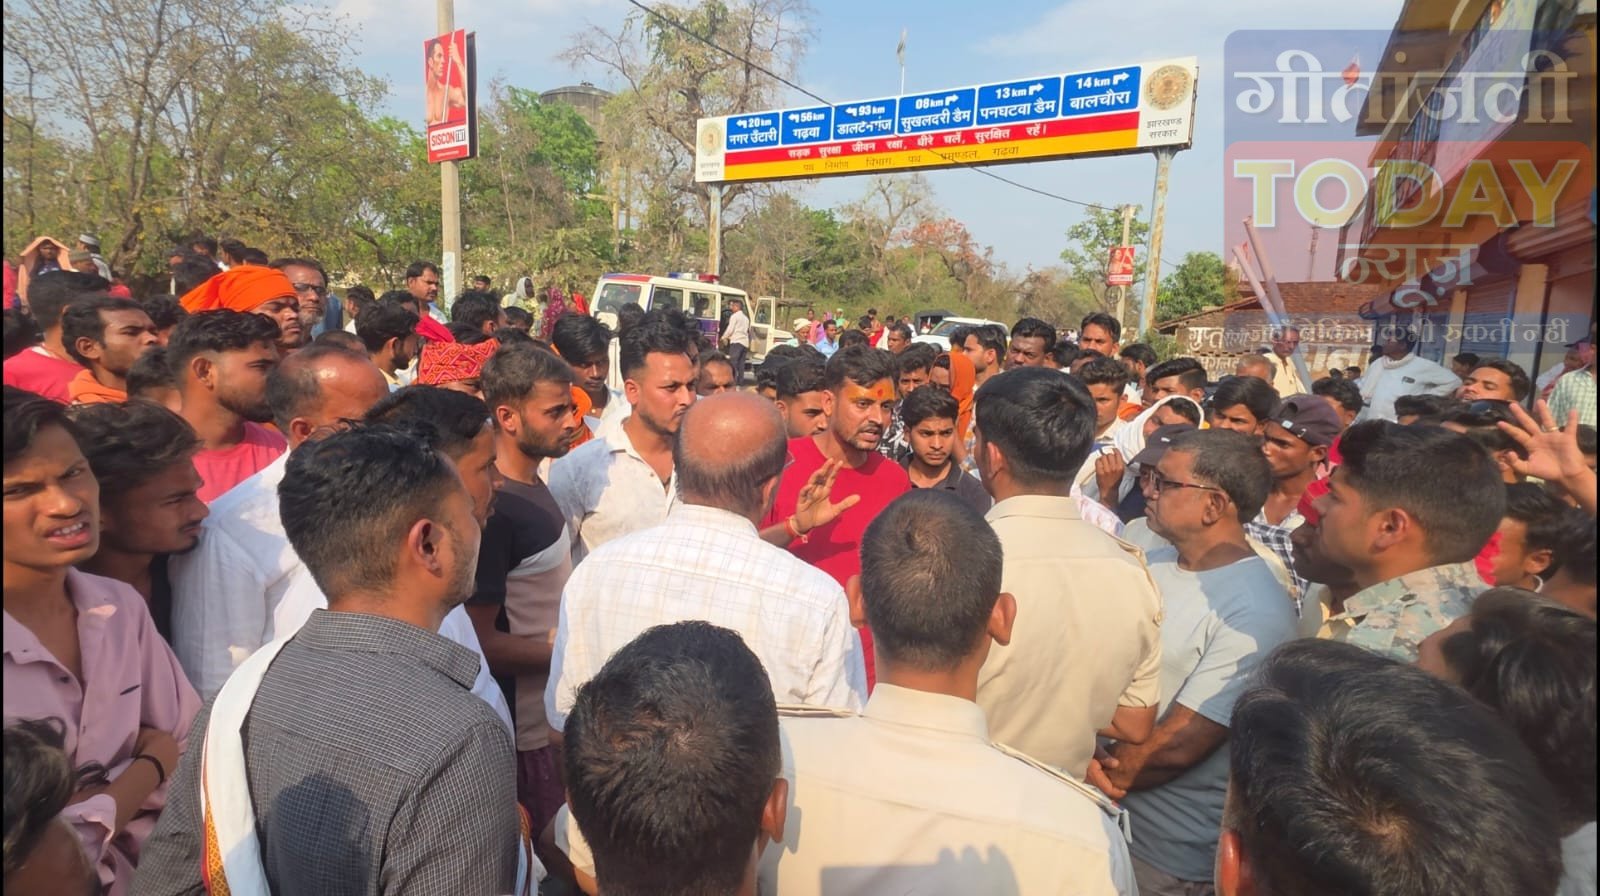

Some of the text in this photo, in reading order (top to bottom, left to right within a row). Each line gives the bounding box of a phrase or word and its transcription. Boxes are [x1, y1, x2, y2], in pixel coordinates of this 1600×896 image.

[1076, 76, 1110, 89] 14 km
[995, 86, 1027, 99] 13 km
[915, 98, 943, 110] 08 km
[1069, 89, 1131, 111] बालचौरा
[858, 105, 885, 116] 93 km
[979, 98, 1056, 119] पनघटवा डैम
[748, 118, 772, 128] 20 km
[800, 111, 825, 122] 56 km
[901, 107, 971, 132] सुखलदरी डैम
[431, 130, 455, 147] SISCON
[729, 134, 749, 145] नगर
[793, 126, 820, 140] गढ़वा
[1149, 129, 1178, 140] सरकार
[788, 148, 811, 159] सड़क
[818, 145, 842, 159] सुरक्षा
[851, 141, 875, 153] जीवन
[917, 134, 934, 146] धीरे
[974, 127, 1011, 143] सुरक्षित
[1188, 326, 1225, 350] गुप्त
